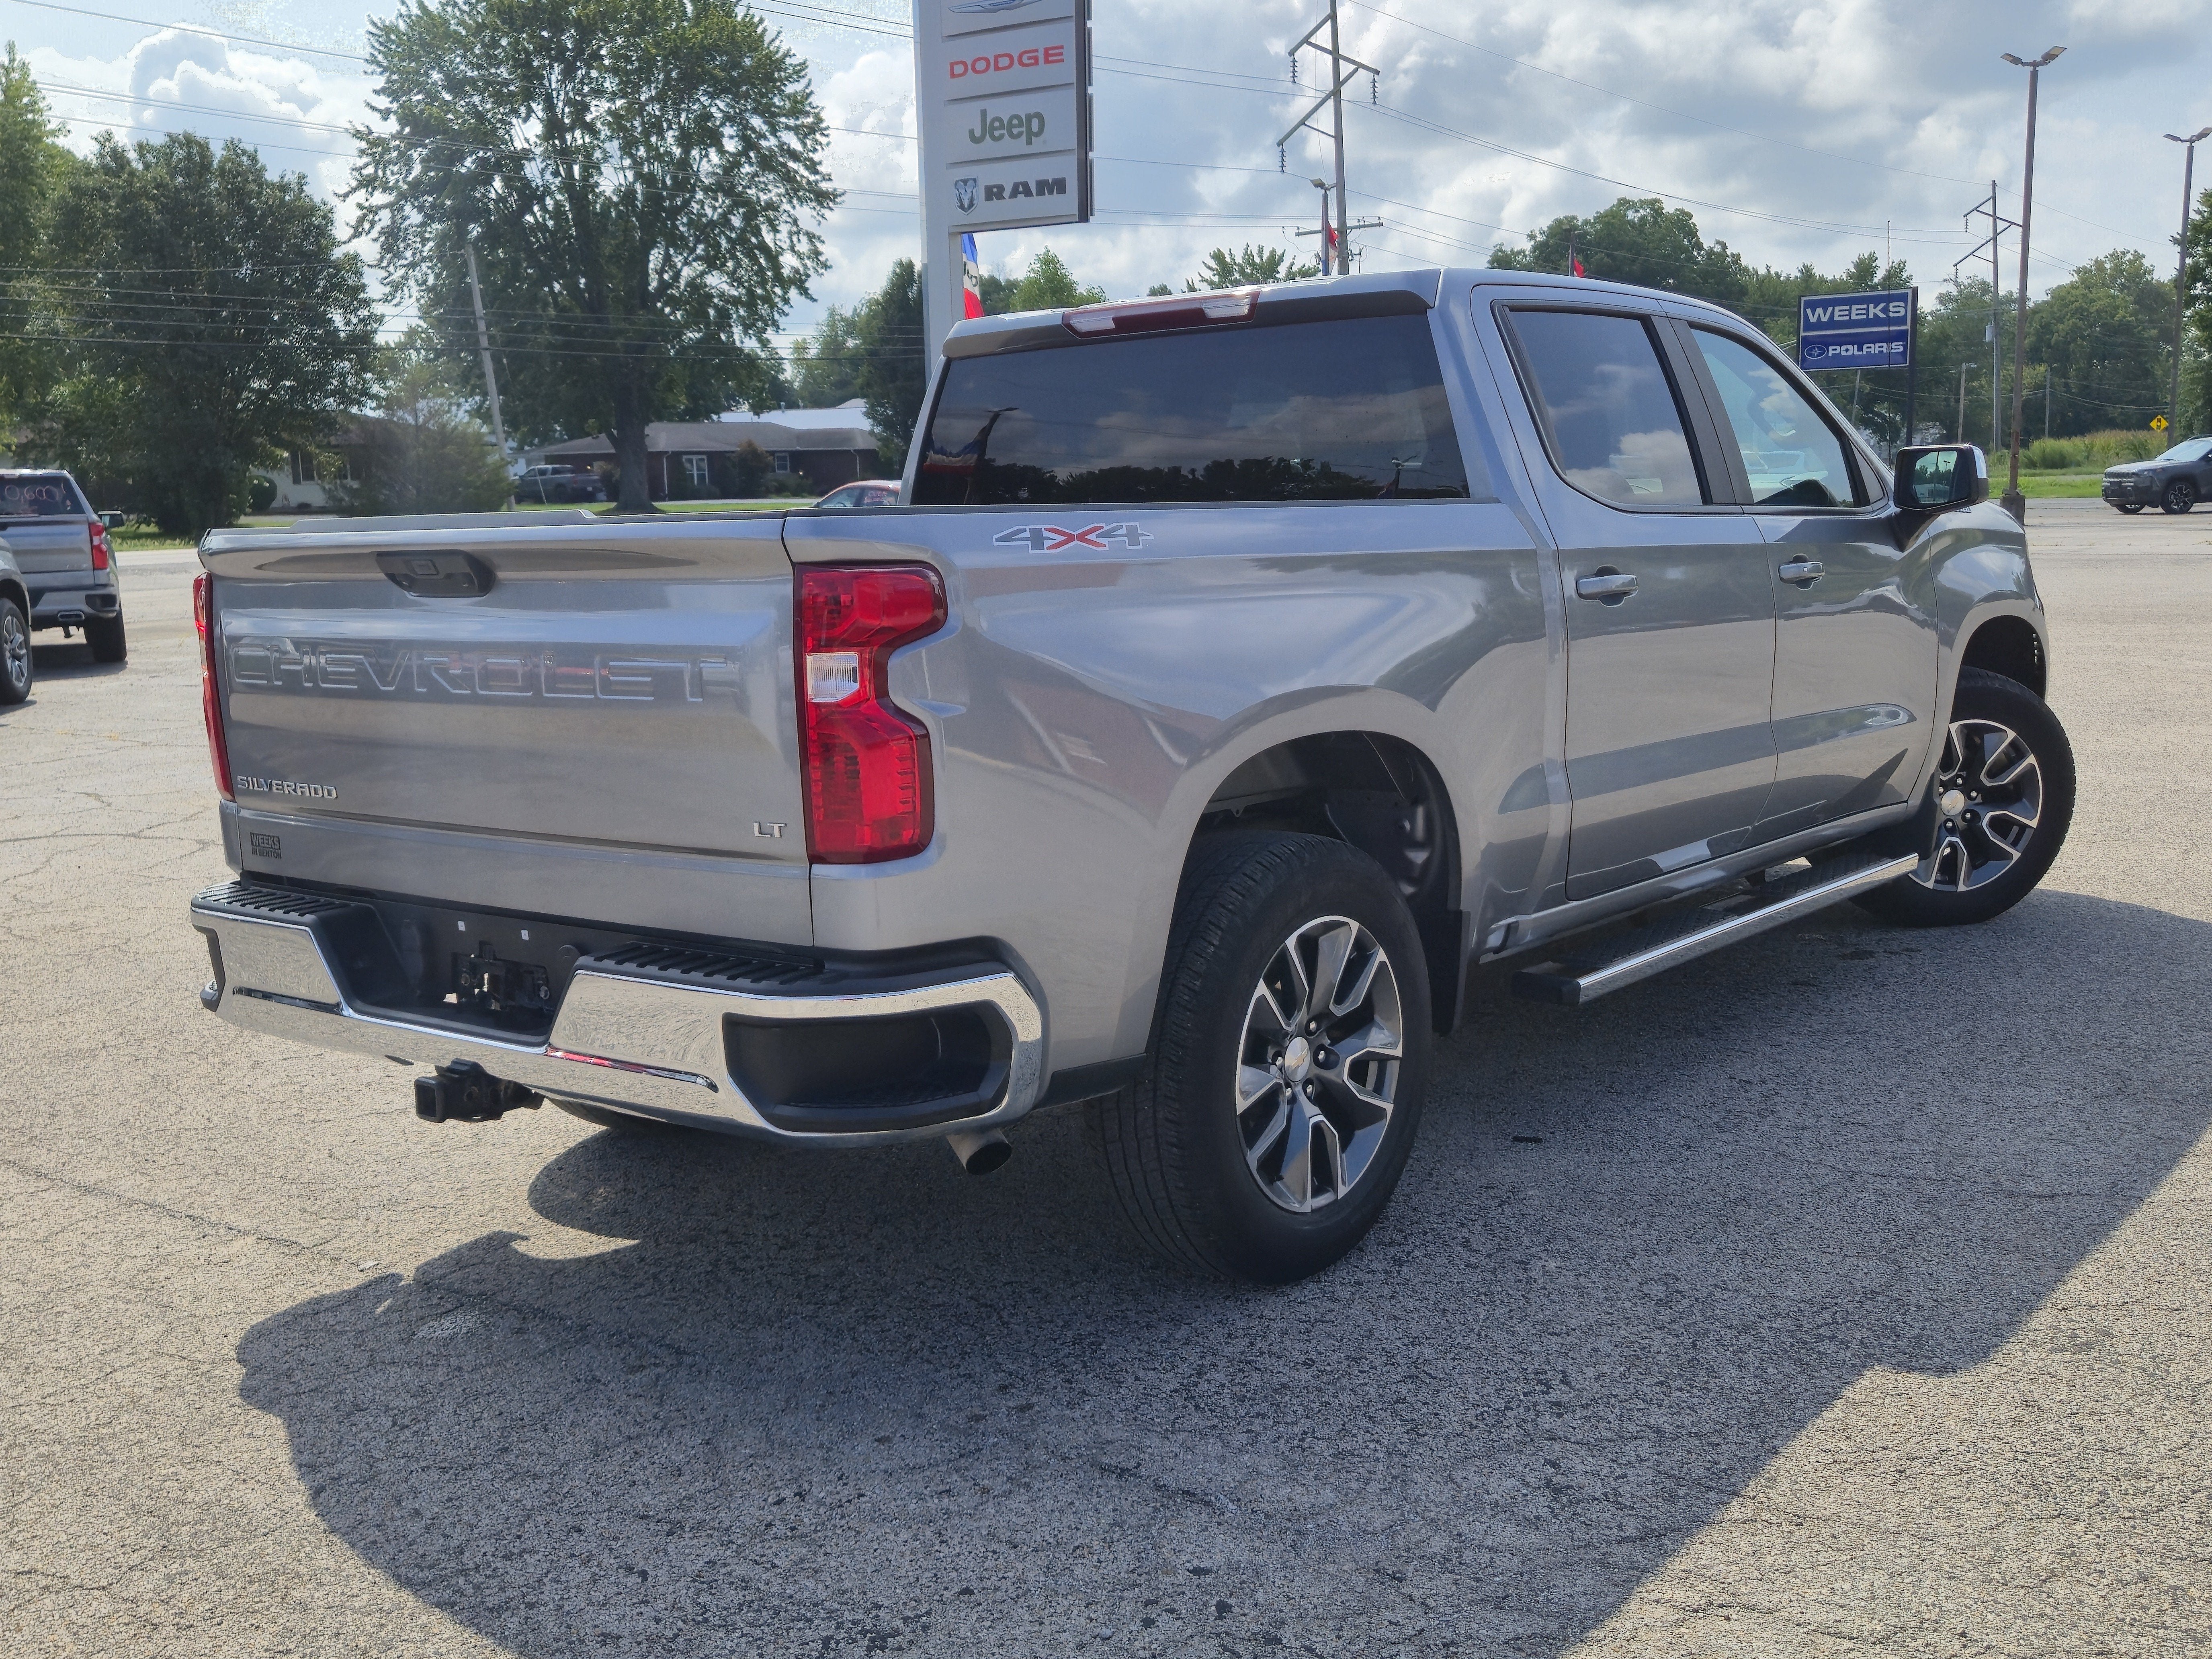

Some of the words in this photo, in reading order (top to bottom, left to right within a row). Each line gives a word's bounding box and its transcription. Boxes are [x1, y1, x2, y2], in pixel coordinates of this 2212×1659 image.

[949, 45, 1064, 79] DODGE
[968, 109, 1045, 145] Jeep
[984, 177, 1067, 202] RAM
[1806, 301, 1905, 322] WEEKS
[1828, 342, 1904, 356] POLARIS
[230, 644, 740, 702] CHEVROLET
[237, 775, 338, 799] SILVERADO
[753, 821, 787, 838] LT
[251, 833, 280, 849] WEEKS
[252, 846, 258, 855] IN
